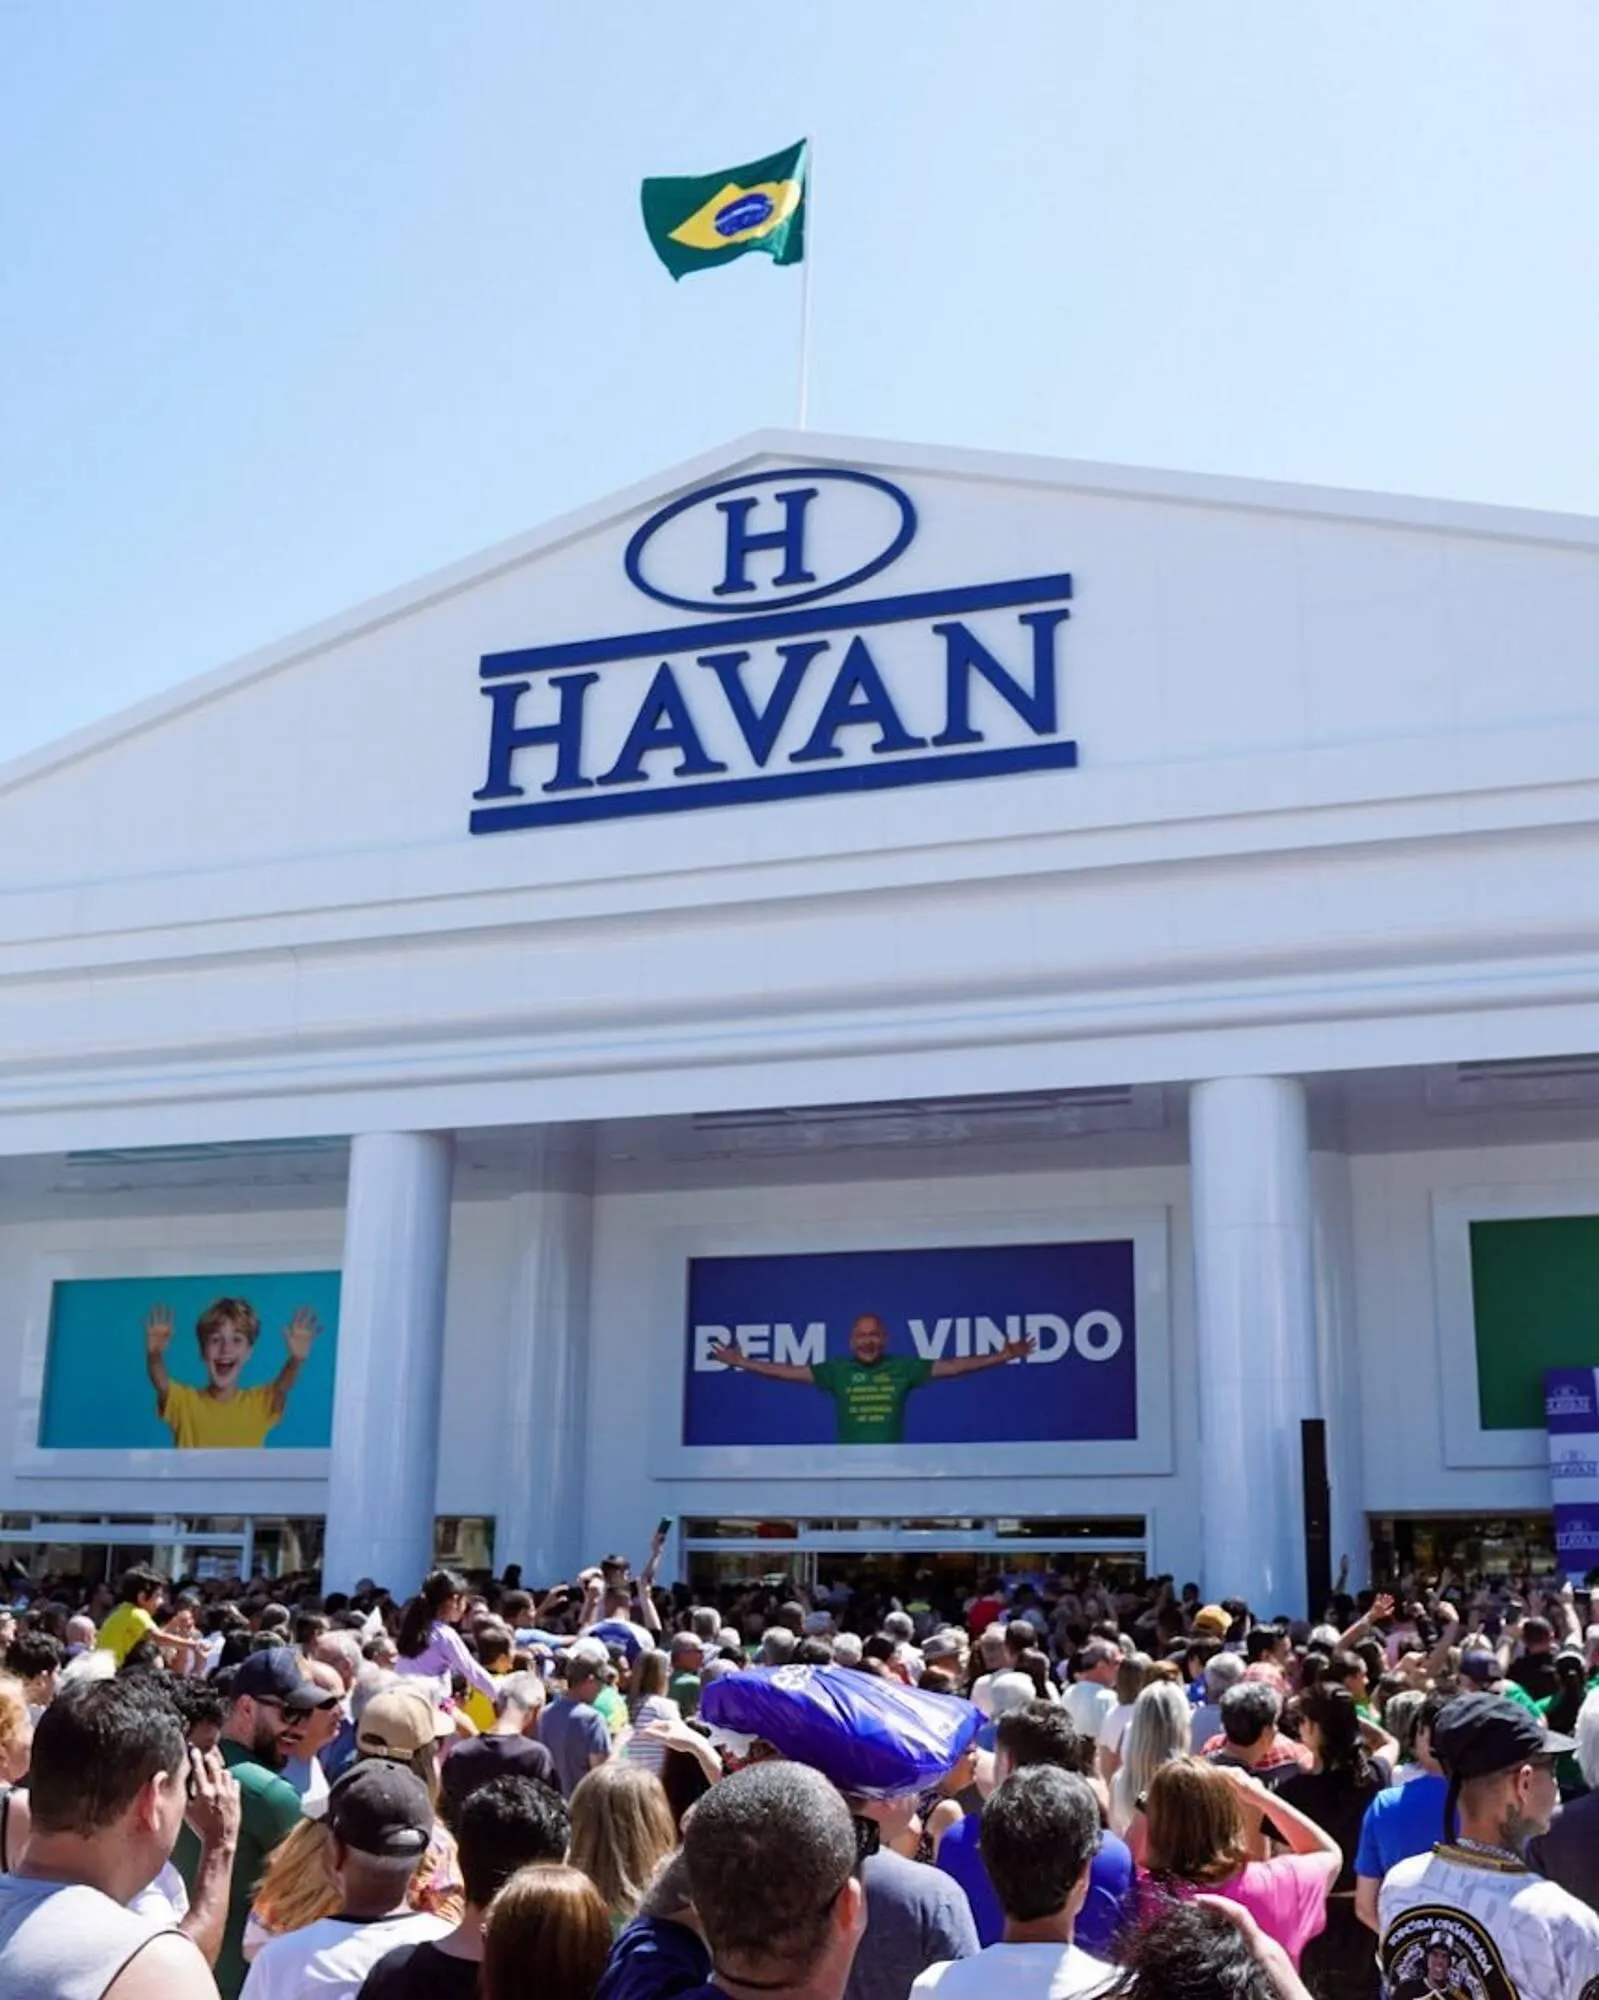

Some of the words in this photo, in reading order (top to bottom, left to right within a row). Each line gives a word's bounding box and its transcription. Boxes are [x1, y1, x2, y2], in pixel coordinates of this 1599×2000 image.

[712, 487, 819, 596] H
[472, 608, 1071, 800] HAVAN
[693, 1322, 826, 1372] BEM
[907, 1310, 1123, 1365] VINDO
